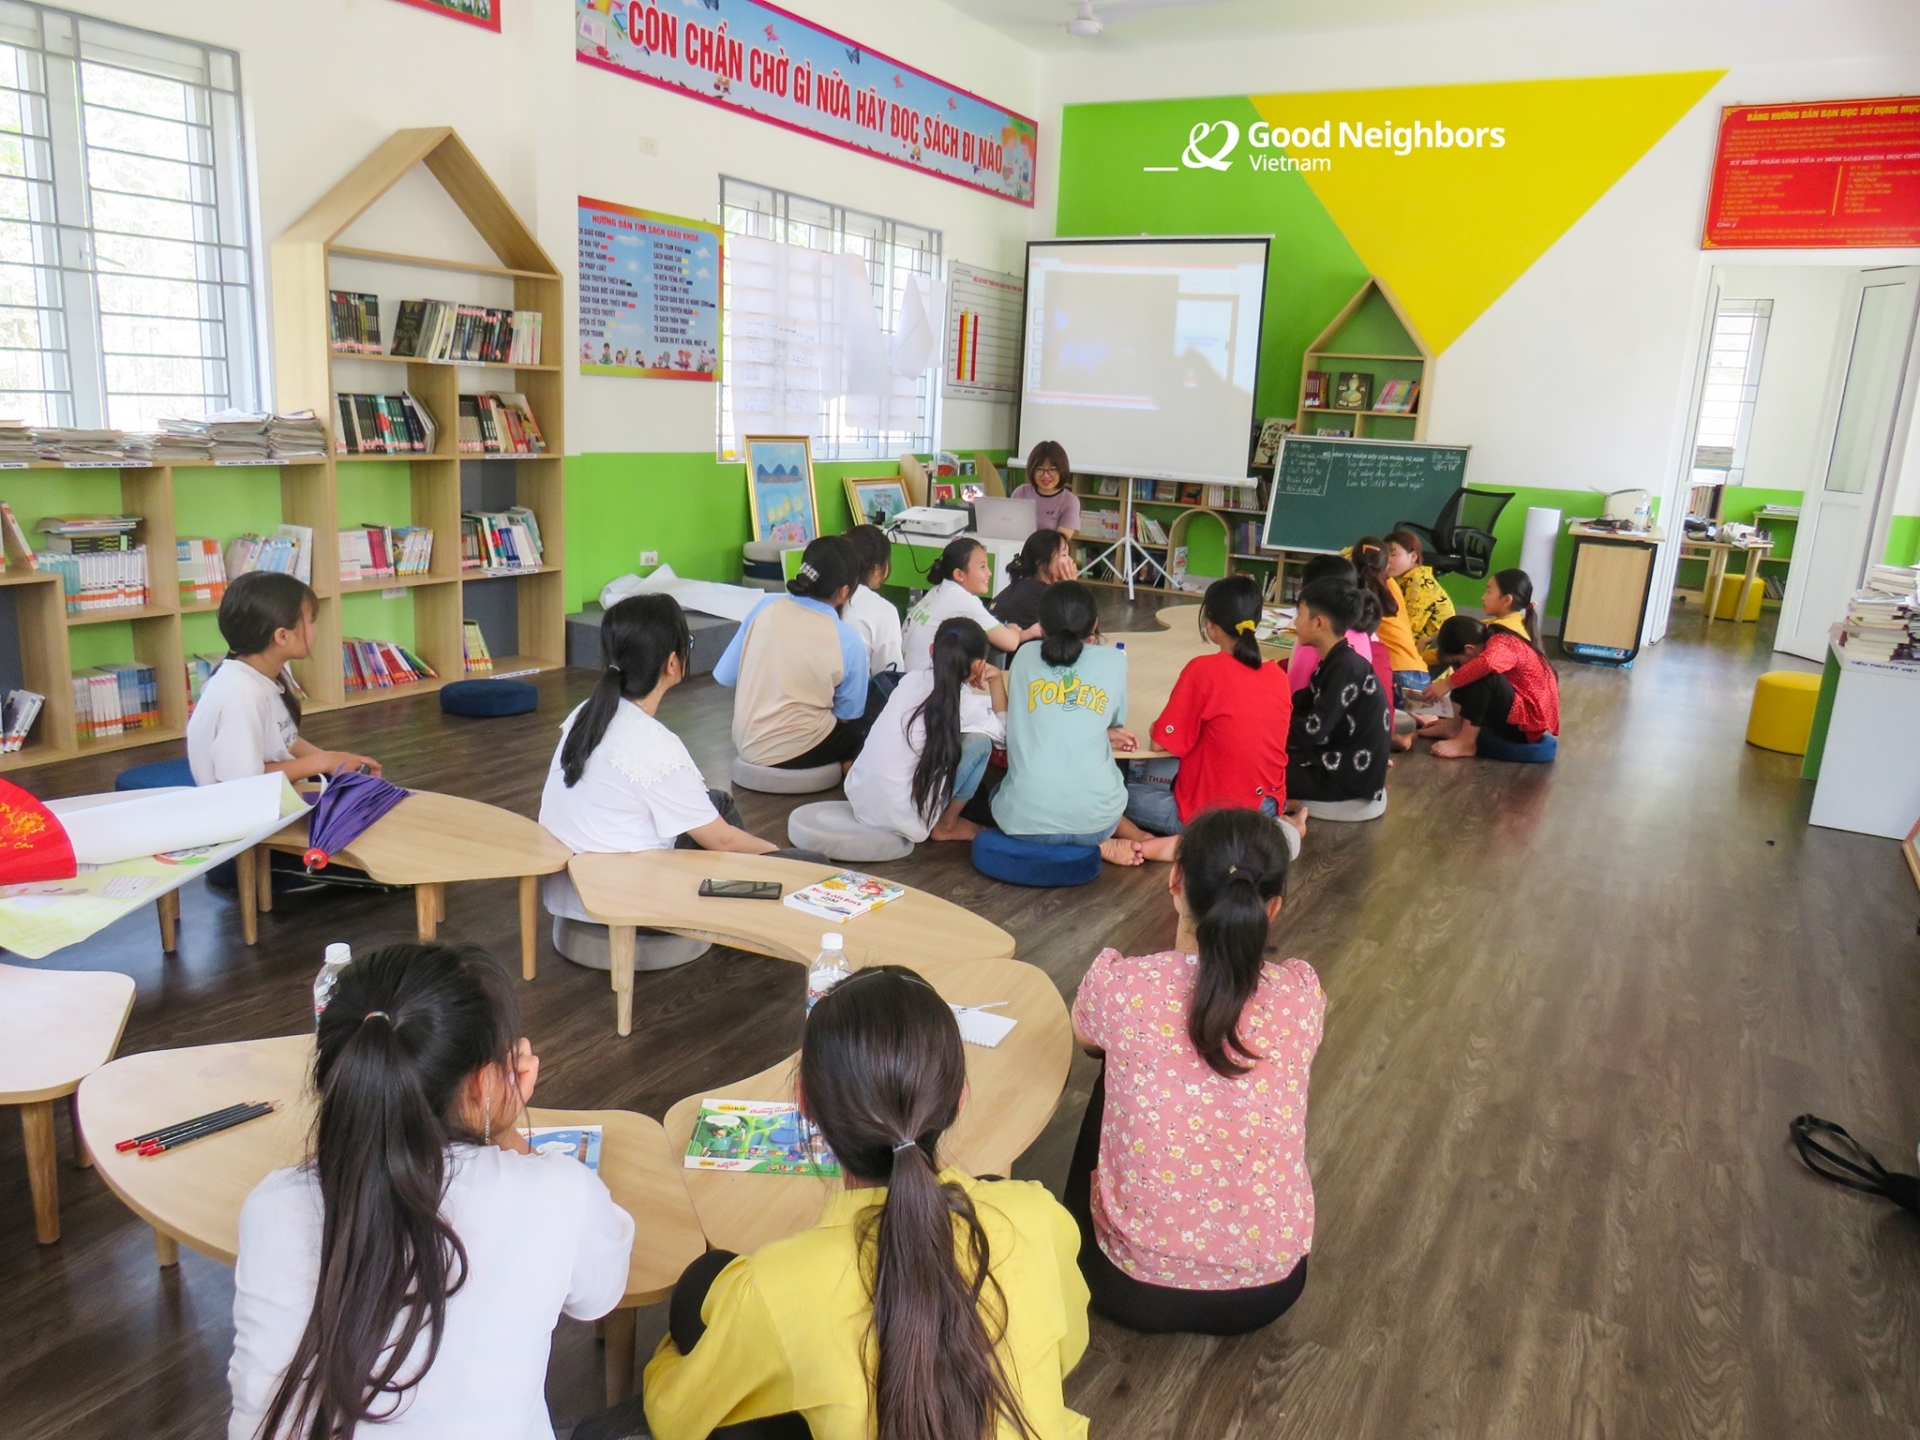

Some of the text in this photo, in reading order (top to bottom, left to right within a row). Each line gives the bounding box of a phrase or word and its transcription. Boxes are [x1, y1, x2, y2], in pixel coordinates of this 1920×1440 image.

[628, 0, 1002, 175] CÒN CHẦN CHỜ GÌ NỮA HÃY ĐỌC SÁCH ĐI NÀO
[592, 215, 616, 227] HƯỚNG
[648, 225, 665, 236] SÁCH
[667, 228, 681, 239] GIÁO
[1028, 678, 1109, 715] POPEYE
